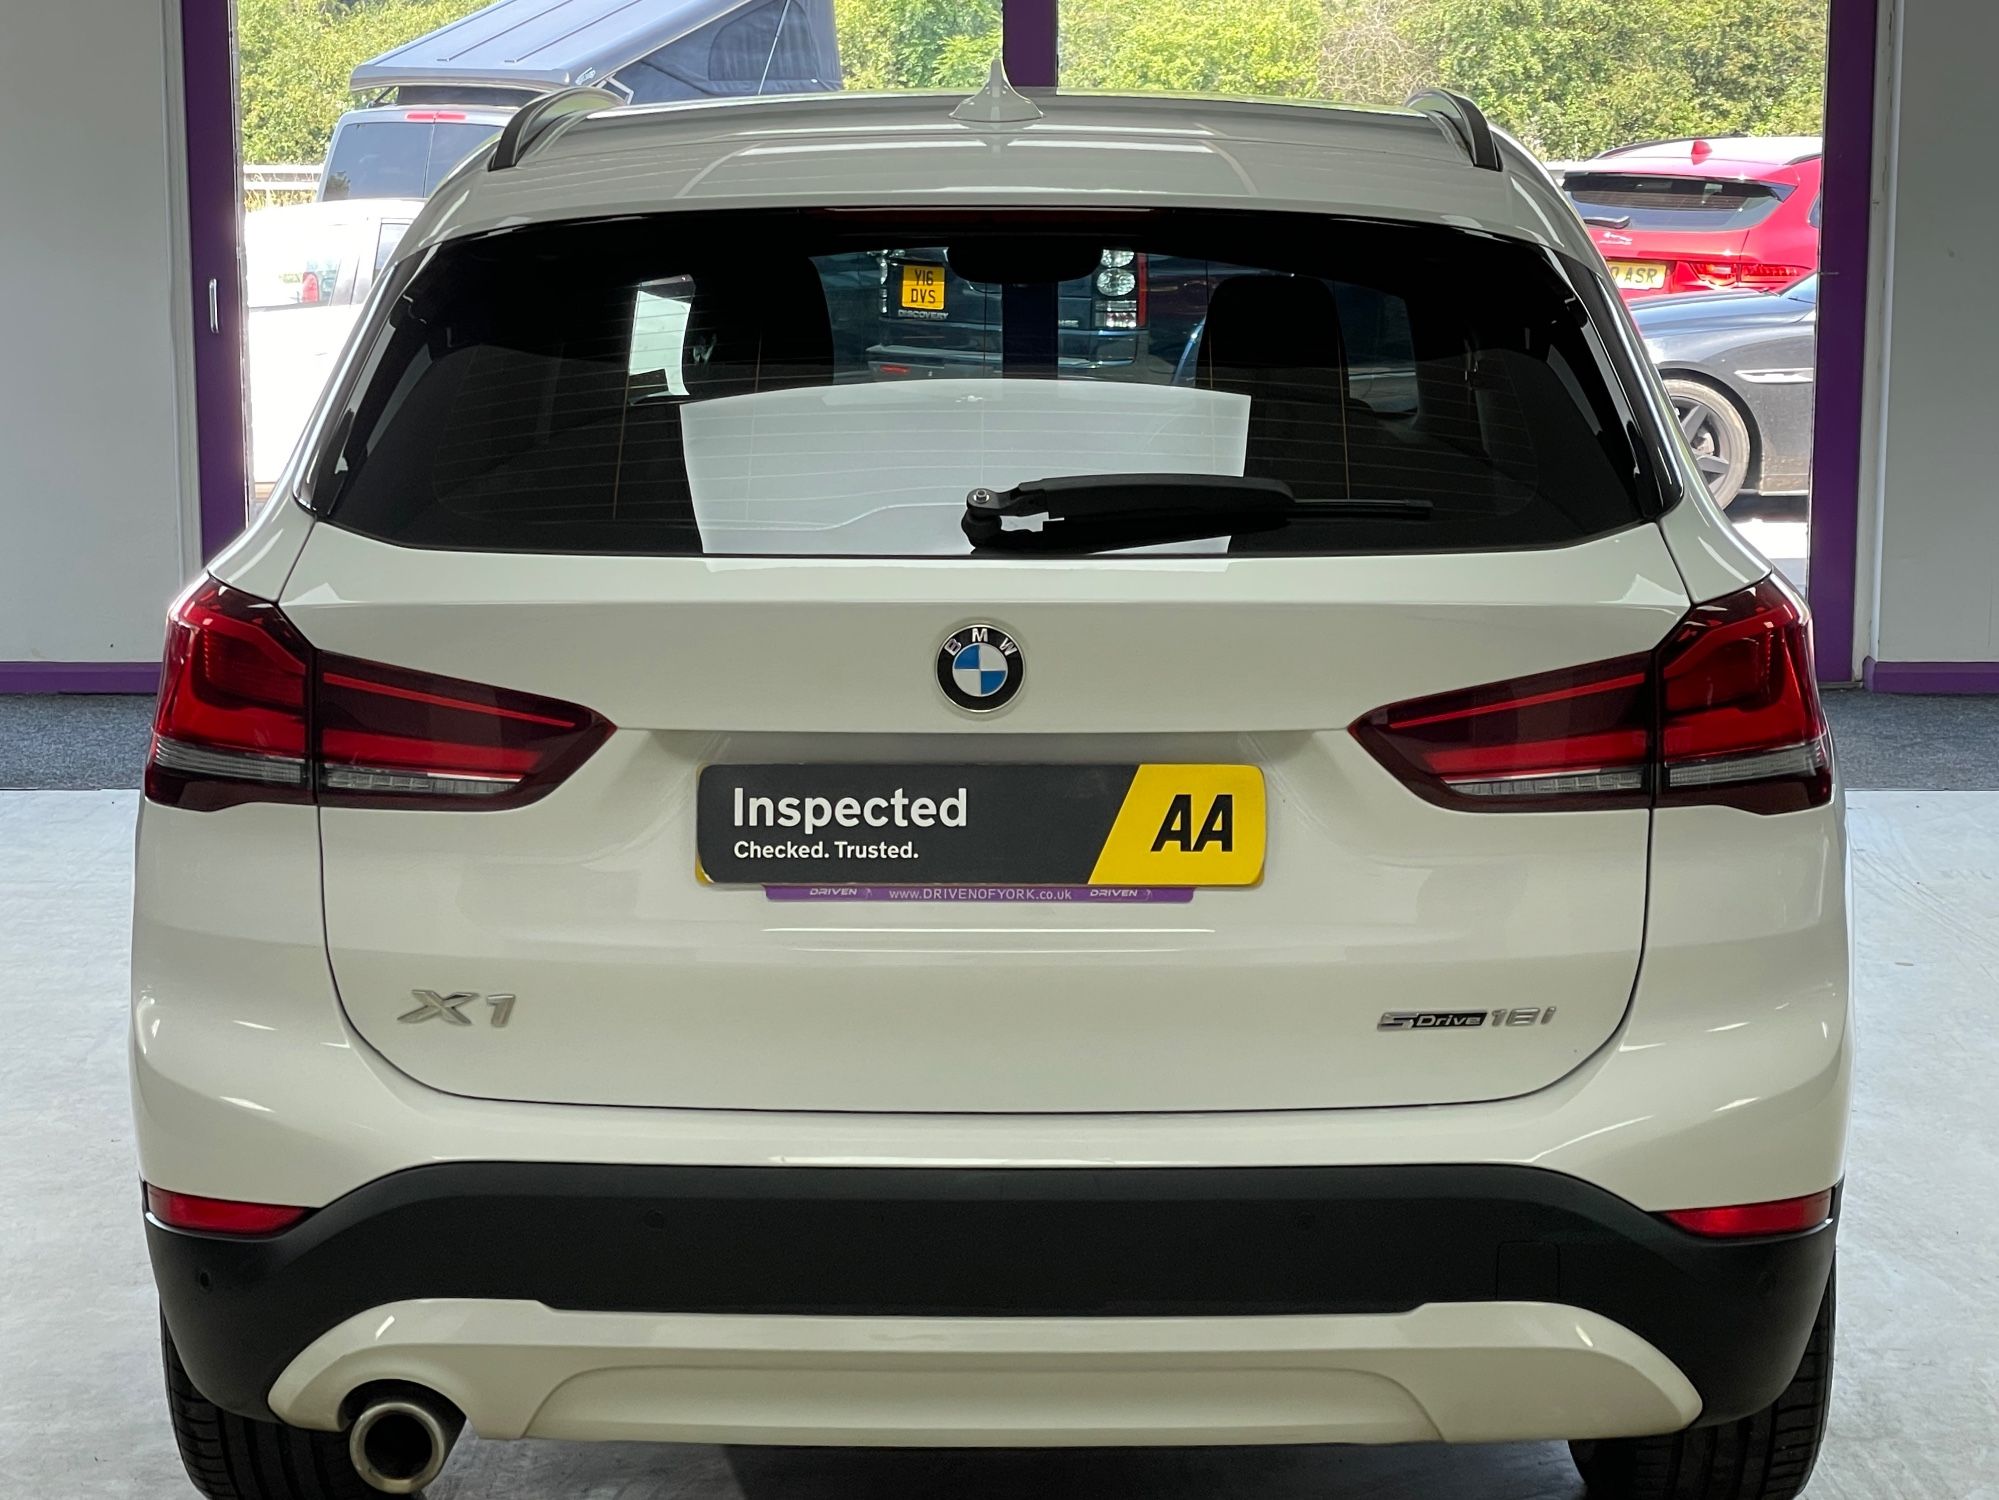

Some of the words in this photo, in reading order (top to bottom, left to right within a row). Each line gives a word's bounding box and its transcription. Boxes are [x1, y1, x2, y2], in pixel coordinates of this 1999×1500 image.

[914, 269, 934, 286] Y16
[1624, 266, 1658, 284] ASR
[911, 288, 936, 304] DVS
[898, 309, 949, 320] DISCOVERY
[943, 627, 1018, 656] BMW
[733, 787, 967, 835] Inspected
[1150, 793, 1233, 852] AA
[733, 841, 830, 859] Checked.
[834, 841, 919, 859] Trusted.
[809, 887, 858, 897] DRIVEN
[888, 887, 1072, 901] www.DRIVENOFYORK.co.uk
[1090, 888, 1138, 898] DRIVEN
[397, 988, 516, 1028] X1
